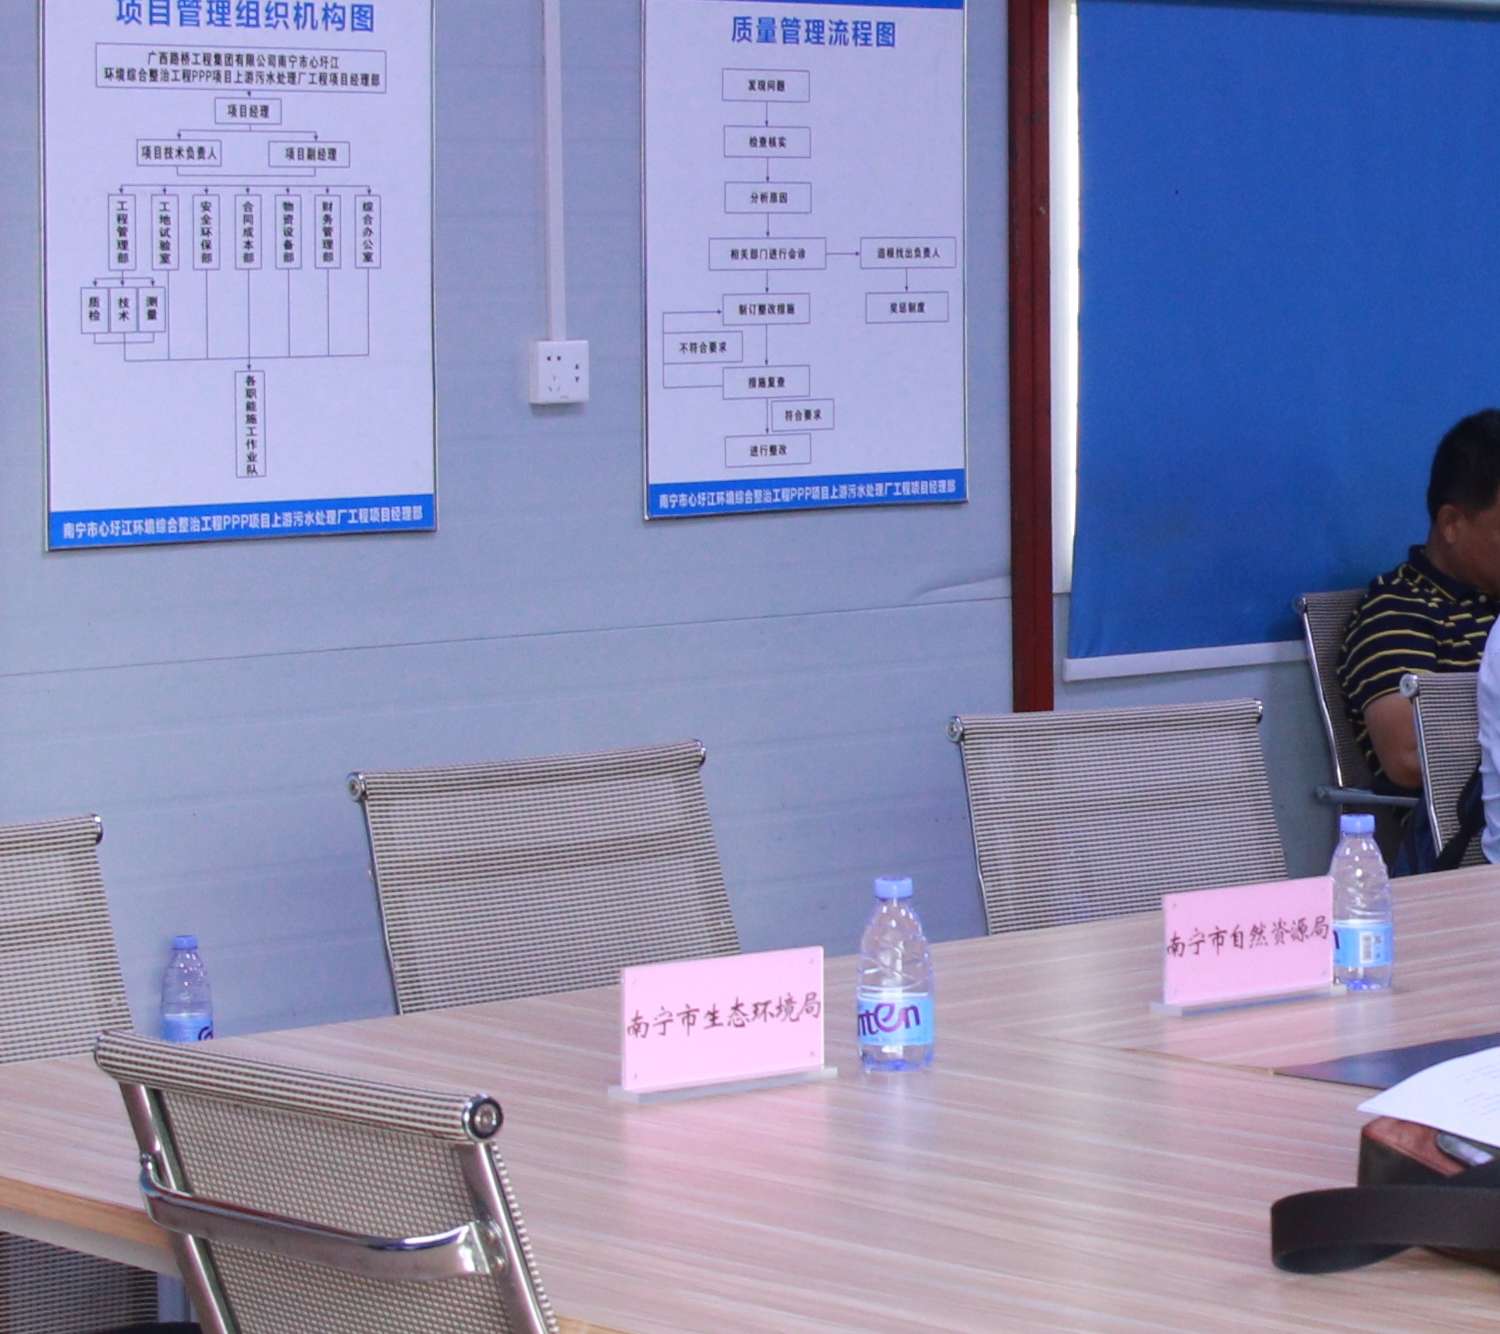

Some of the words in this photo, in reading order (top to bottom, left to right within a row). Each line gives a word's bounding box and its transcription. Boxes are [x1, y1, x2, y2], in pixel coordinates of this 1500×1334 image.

[731, 15, 896, 48] 质量管理流程图
[147, 51, 340, 69] 广西路桥工程集团有限公司南宁市心圩江
[748, 79, 786, 92] 发现问题
[227, 104, 270, 119] 项目经理
[141, 145, 218, 161] 项目技术负责人
[285, 147, 338, 162] 项目副经理
[749, 135, 788, 149] 检查核实
[750, 191, 788, 205] 分析原因
[116, 201, 129, 264] 工程管理部
[158, 201, 171, 265] 工地试验室
[200, 201, 213, 264] 安全环保部
[242, 201, 255, 264] 合同成本部
[282, 201, 295, 264] 物资设备部
[322, 201, 334, 263] 财务管理部
[362, 201, 374, 263] 综合办公室
[730, 247, 806, 262] 相关部门进行会诊
[88, 296, 100, 322] 质检
[118, 296, 130, 322] 技术
[146, 296, 158, 322] 测量
[738, 303, 796, 316] 制订整改措施
[889, 301, 926, 314] 奖惩制度
[679, 341, 728, 354] 不符合要求
[748, 376, 786, 390] 措施复查
[245, 375, 258, 476] 各职能施工作业队
[784, 409, 822, 422] 符合要求
[749, 444, 787, 458] 进行整改
[63, 504, 424, 540] 南宁市心圩江环境综合整治工程PPP项目上游污水处理厂工程项目经理部
[1166, 915, 1330, 959] 南宁市自然资源局
[626, 990, 822, 1040] 南宁市生态环境局
